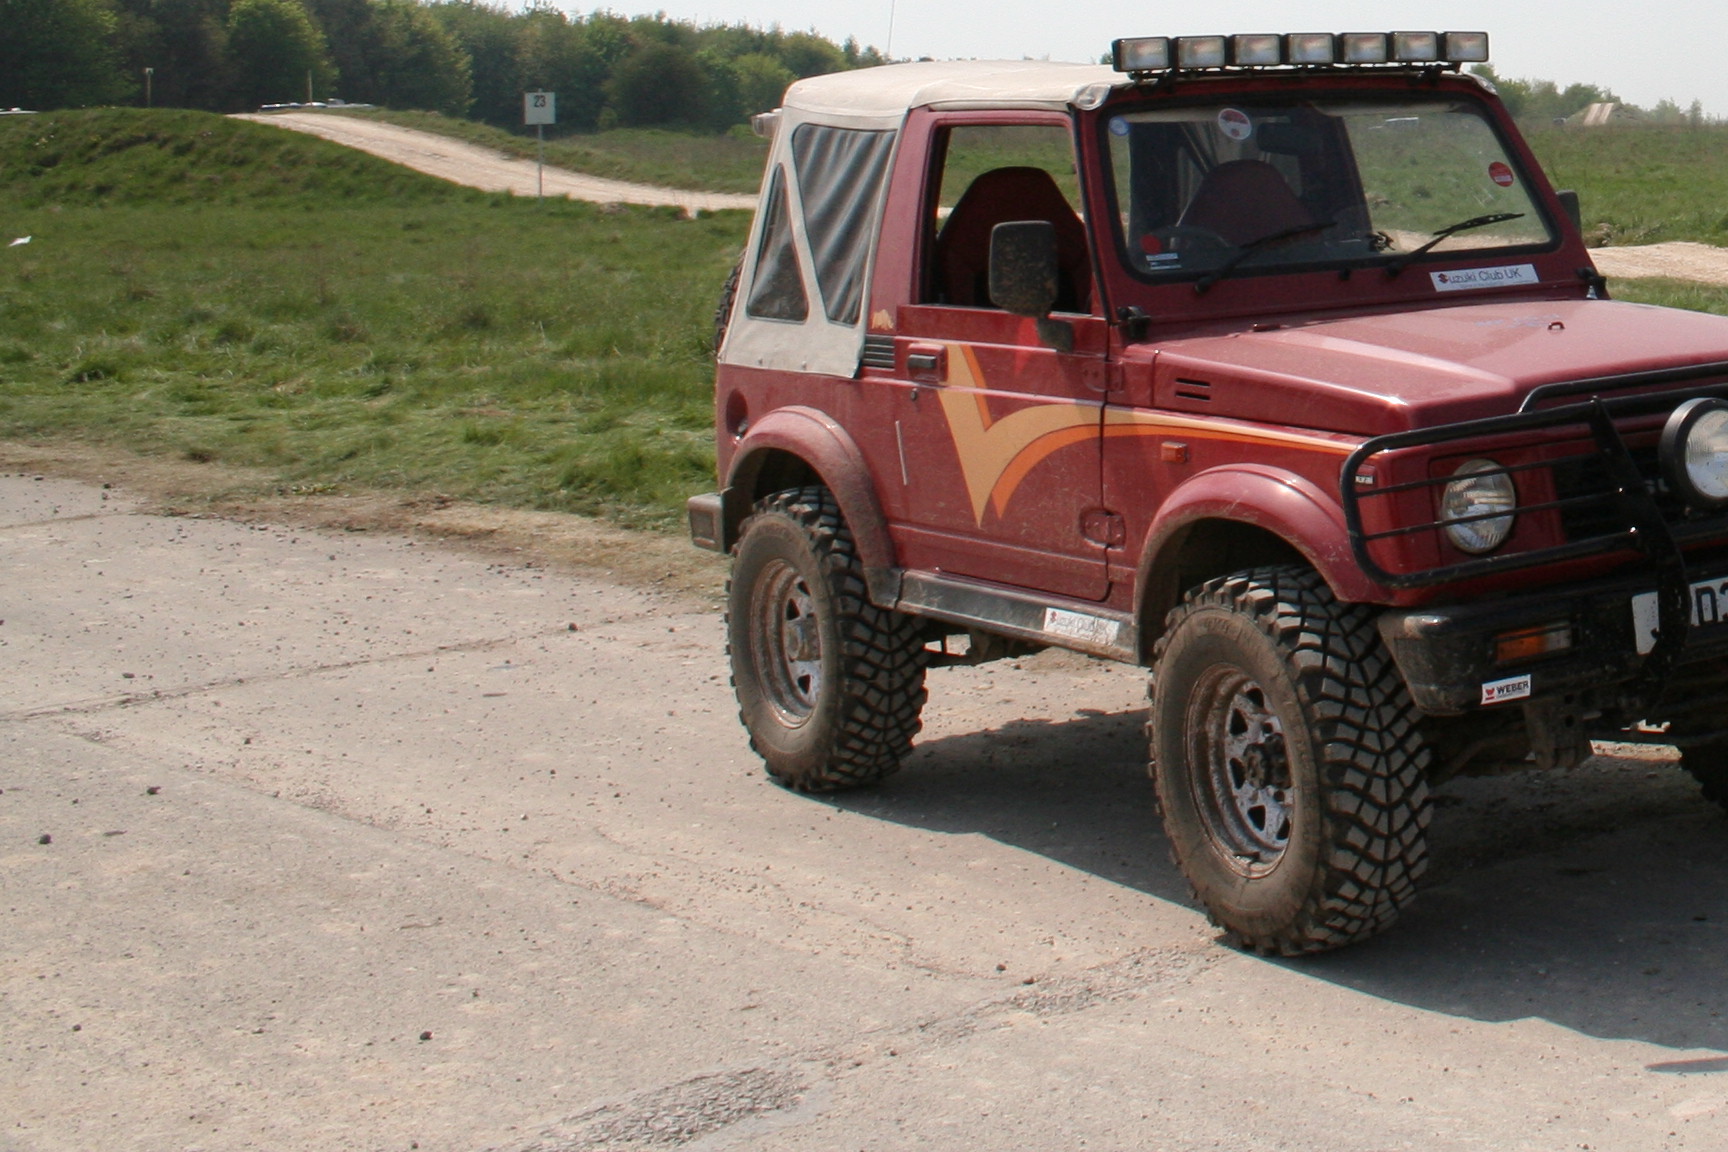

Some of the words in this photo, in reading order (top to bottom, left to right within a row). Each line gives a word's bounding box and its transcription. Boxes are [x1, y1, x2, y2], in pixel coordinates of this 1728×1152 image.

[534, 95, 546, 108] 23
[1479, 269, 1504, 281] Club
[1504, 268, 1522, 279] UK
[1497, 680, 1529, 694] WEBER
